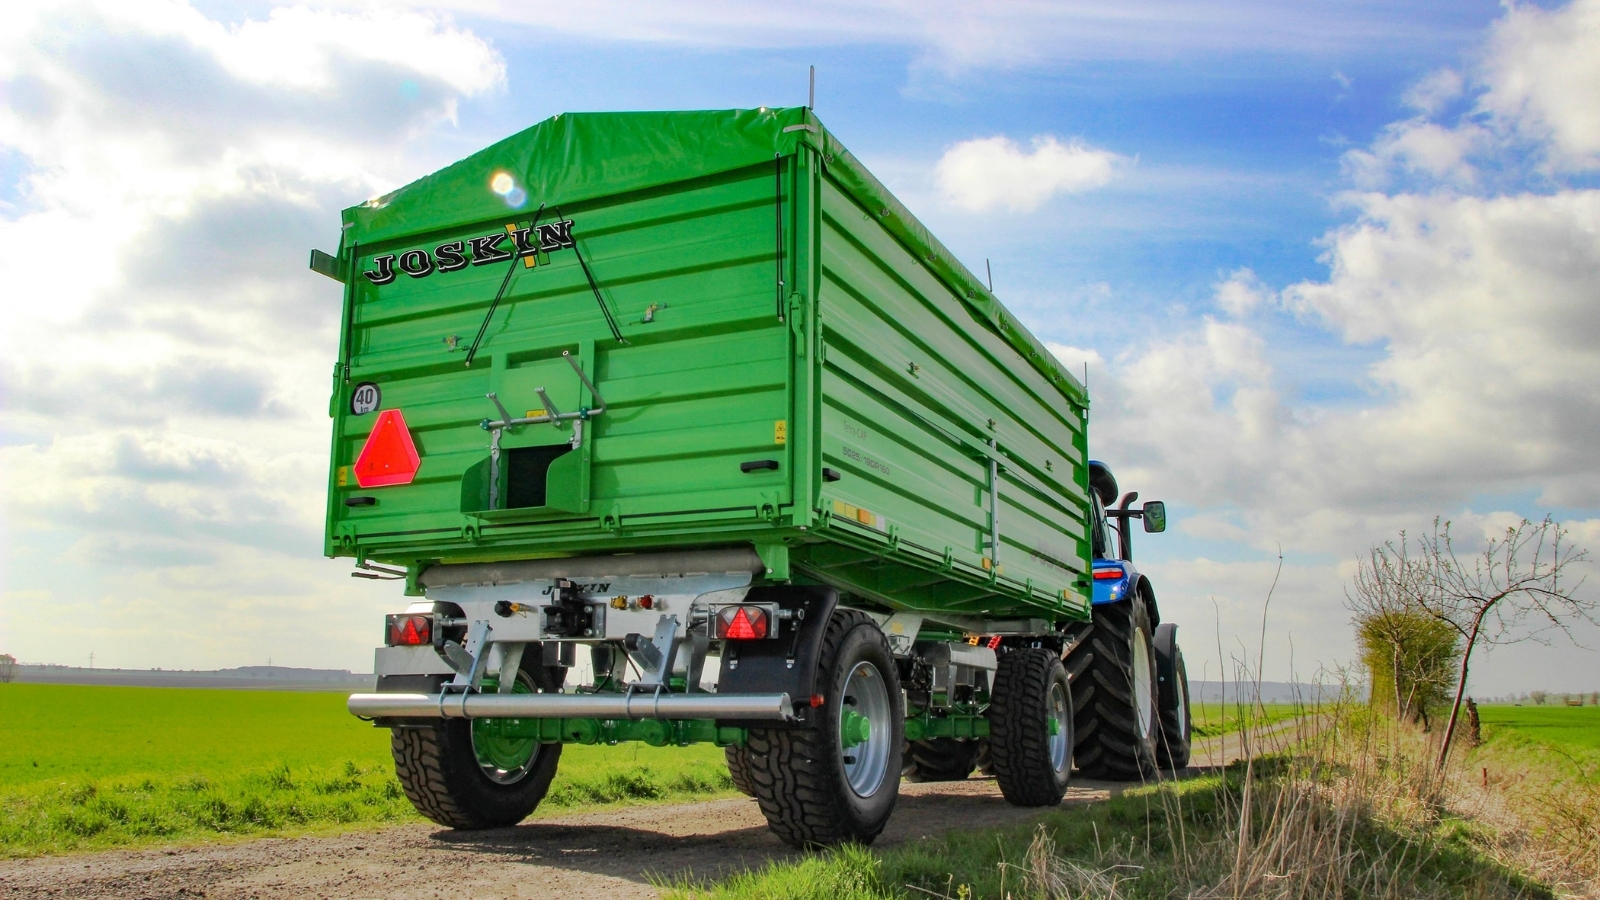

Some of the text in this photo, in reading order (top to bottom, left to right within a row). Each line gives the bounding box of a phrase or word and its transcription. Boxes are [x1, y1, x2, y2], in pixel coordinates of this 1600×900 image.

[363, 219, 575, 285] JOSKIN
[356, 388, 373, 405] 40
[542, 583, 611, 596] JKIN
